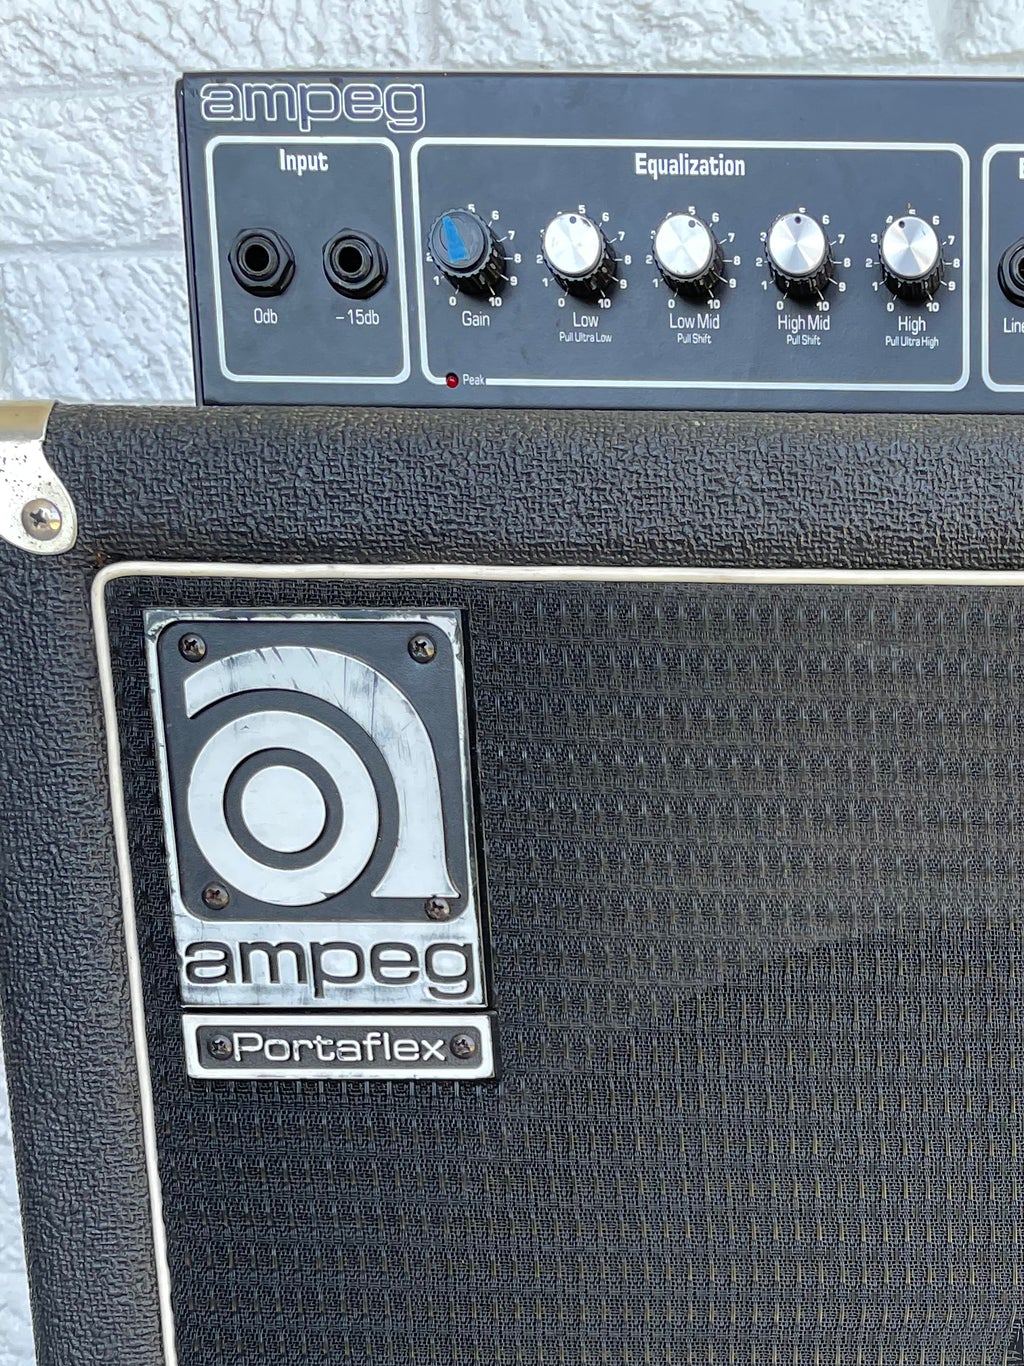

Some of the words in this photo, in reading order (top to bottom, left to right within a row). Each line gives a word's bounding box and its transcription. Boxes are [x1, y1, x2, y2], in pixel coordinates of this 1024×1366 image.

[200, 83, 425, 133] ampeg
[280, 149, 328, 175] Input
[635, 152, 745, 180] Equalization
[578, 205, 585, 214] 5
[688, 206, 695, 215] 5
[492, 211, 499, 220] 6
[602, 213, 609, 221] 6
[712, 213, 719, 222] 6
[823, 215, 829, 224] 6
[933, 216, 939, 225] 6
[508, 231, 515, 240] 7
[618, 232, 625, 240] 7
[728, 233, 735, 242] 7
[760, 232, 766, 241] 3
[838, 234, 845, 243] 7
[871, 234, 878, 243] 3
[948, 236, 955, 245] 7
[514, 254, 521, 263] 8
[537, 255, 543, 263] 2
[625, 256, 631, 264] 8
[646, 255, 652, 264] 2
[734, 256, 741, 265] 8
[756, 258, 762, 266] 2
[844, 258, 851, 267] 8
[866, 259, 872, 267] 2
[953, 259, 960, 267] 8
[433, 276, 439, 285] 1
[510, 276, 517, 285] 9
[543, 278, 548, 287] 1
[620, 280, 627, 289] 9
[653, 279, 658, 288] 1
[729, 279, 736, 288] 9
[761, 281, 767, 289] 1
[839, 283, 846, 292] 9
[872, 282, 878, 291] 1
[948, 281, 955, 291] 9
[449, 297, 456, 306] 0
[489, 297, 502, 306] 10
[558, 298, 565, 307] 0
[598, 299, 611, 308] 10
[668, 300, 675, 308] 0
[708, 300, 720, 309] 10
[777, 301, 784, 310] 0
[817, 302, 829, 311] 10
[887, 303, 894, 311] 0
[927, 302, 939, 312] 10
[462, 311, 490, 326] Gain
[573, 312, 598, 327] Low
[670, 313, 695, 328] Low
[697, 314, 720, 329] Mid
[778, 315, 805, 333] High
[808, 315, 830, 330] Mid
[898, 316, 926, 335] High
[560, 332, 573, 341] Pull
[575, 333, 595, 342] Ultra
[596, 333, 612, 342] Low
[678, 333, 691, 343] Pull
[693, 334, 711, 344] Shift
[786, 334, 800, 346] Pull
[802, 334, 821, 346] Shift
[886, 335, 899, 346] Pull
[901, 335, 921, 347] Ultra
[921, 336, 939, 349] High
[463, 374, 485, 386] Peak
[184, 939, 476, 1000] ampeg
[232, 1032, 447, 1063] Portaflex
